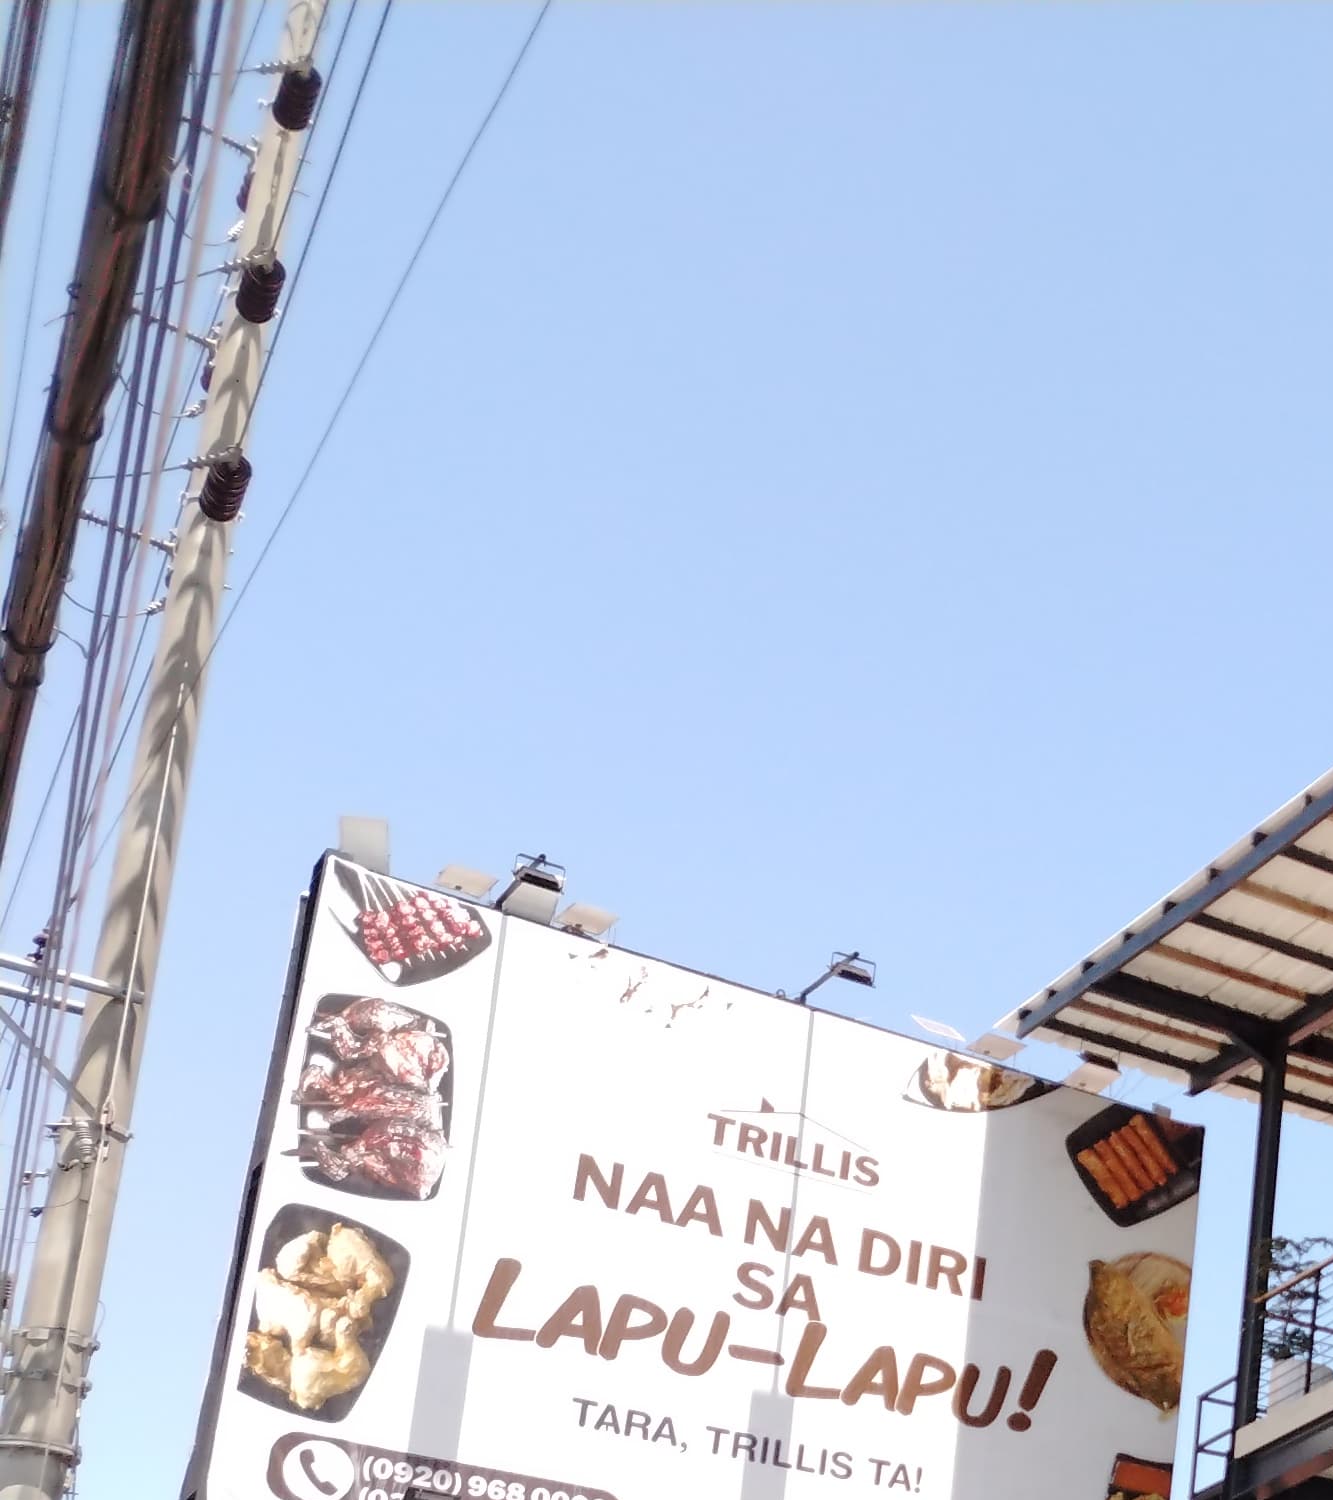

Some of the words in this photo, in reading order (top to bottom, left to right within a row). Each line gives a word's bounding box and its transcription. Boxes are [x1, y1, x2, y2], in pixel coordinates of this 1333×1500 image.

[707, 1113, 880, 1188] TRILLIS
[573, 1153, 723, 1237] NAA
[743, 1198, 838, 1267] NA
[858, 1227, 987, 1301] DIRI
[732, 1261, 821, 1321] SA
[362, 1455, 462, 1496] (0920)
[573, 1397, 687, 1452] TARA,
[706, 1425, 854, 1480] TRILLIS
[868, 1458, 923, 1494] TA!
